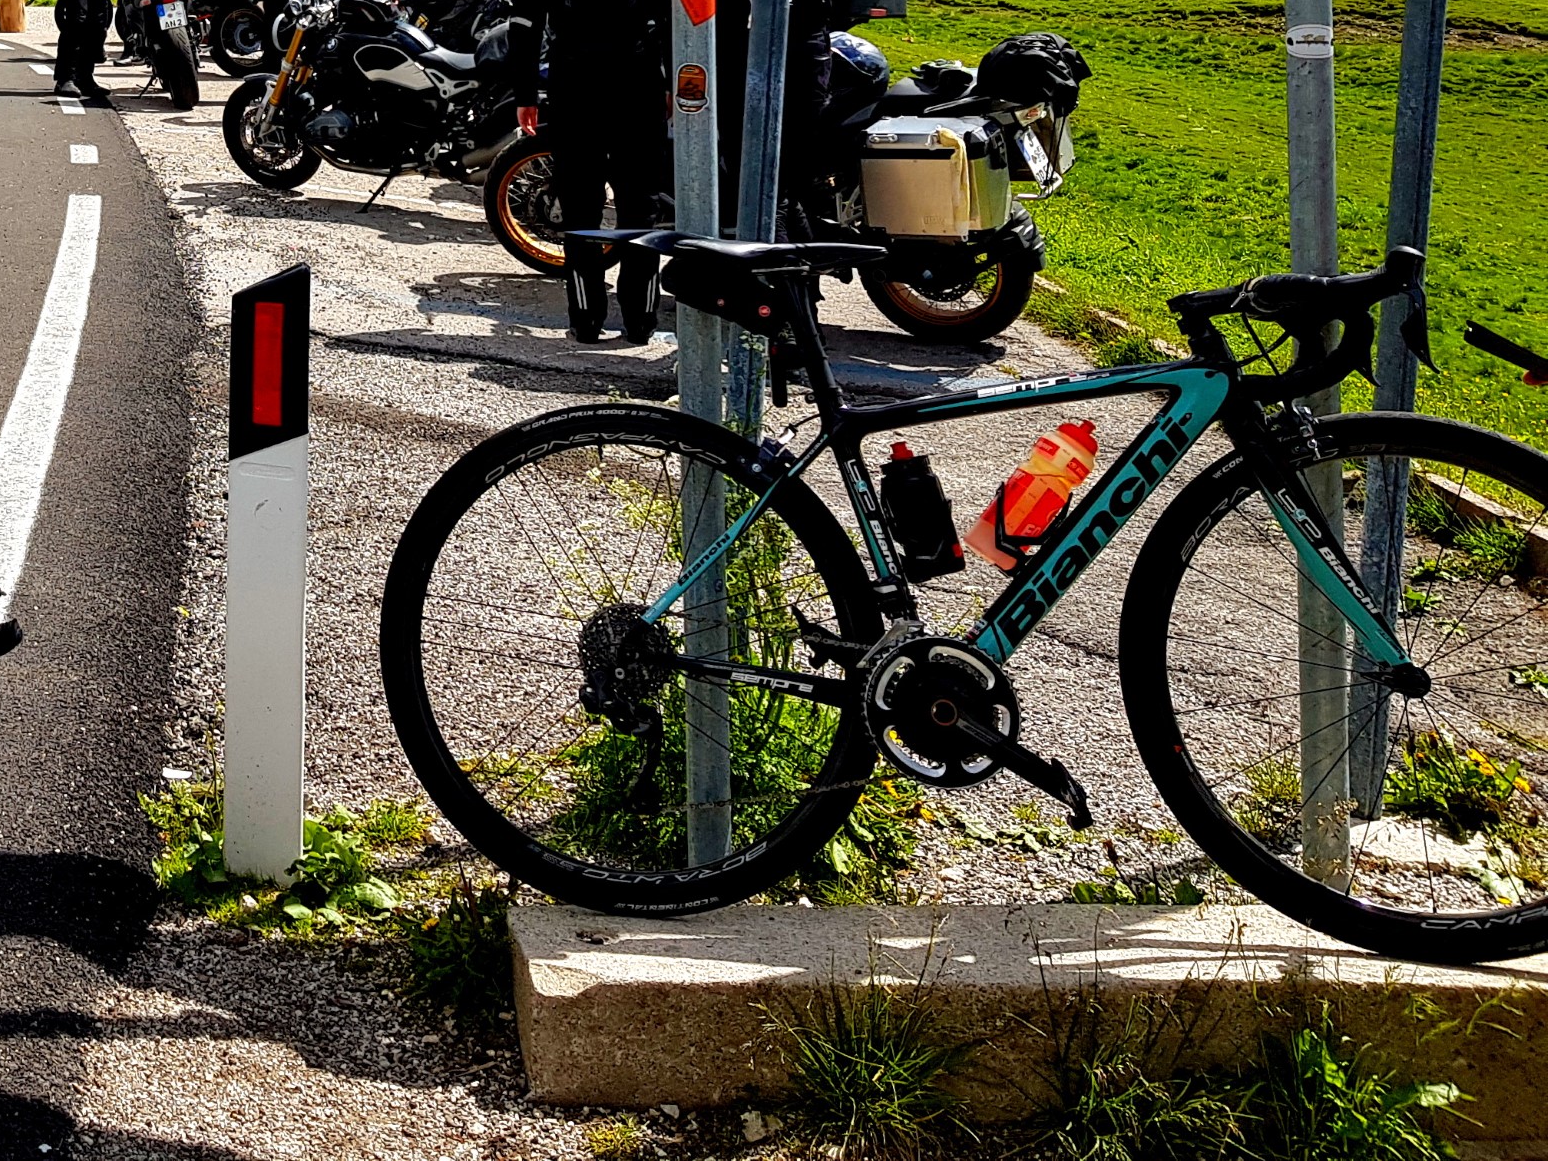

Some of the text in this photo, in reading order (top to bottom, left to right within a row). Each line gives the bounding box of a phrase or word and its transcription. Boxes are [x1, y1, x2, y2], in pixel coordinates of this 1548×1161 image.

[531, 414, 568, 428] GRAND
[568, 410, 595, 419] PRIX
[869, 520, 902, 580] Bianc
[999, 416, 1191, 651] Bianchi
[1180, 486, 1250, 563] BORA
[677, 533, 731, 587] Bianchi
[1317, 546, 1381, 615] Bianchi
[730, 671, 814, 693] sempre
[625, 898, 709, 912] CONTINENTAL
